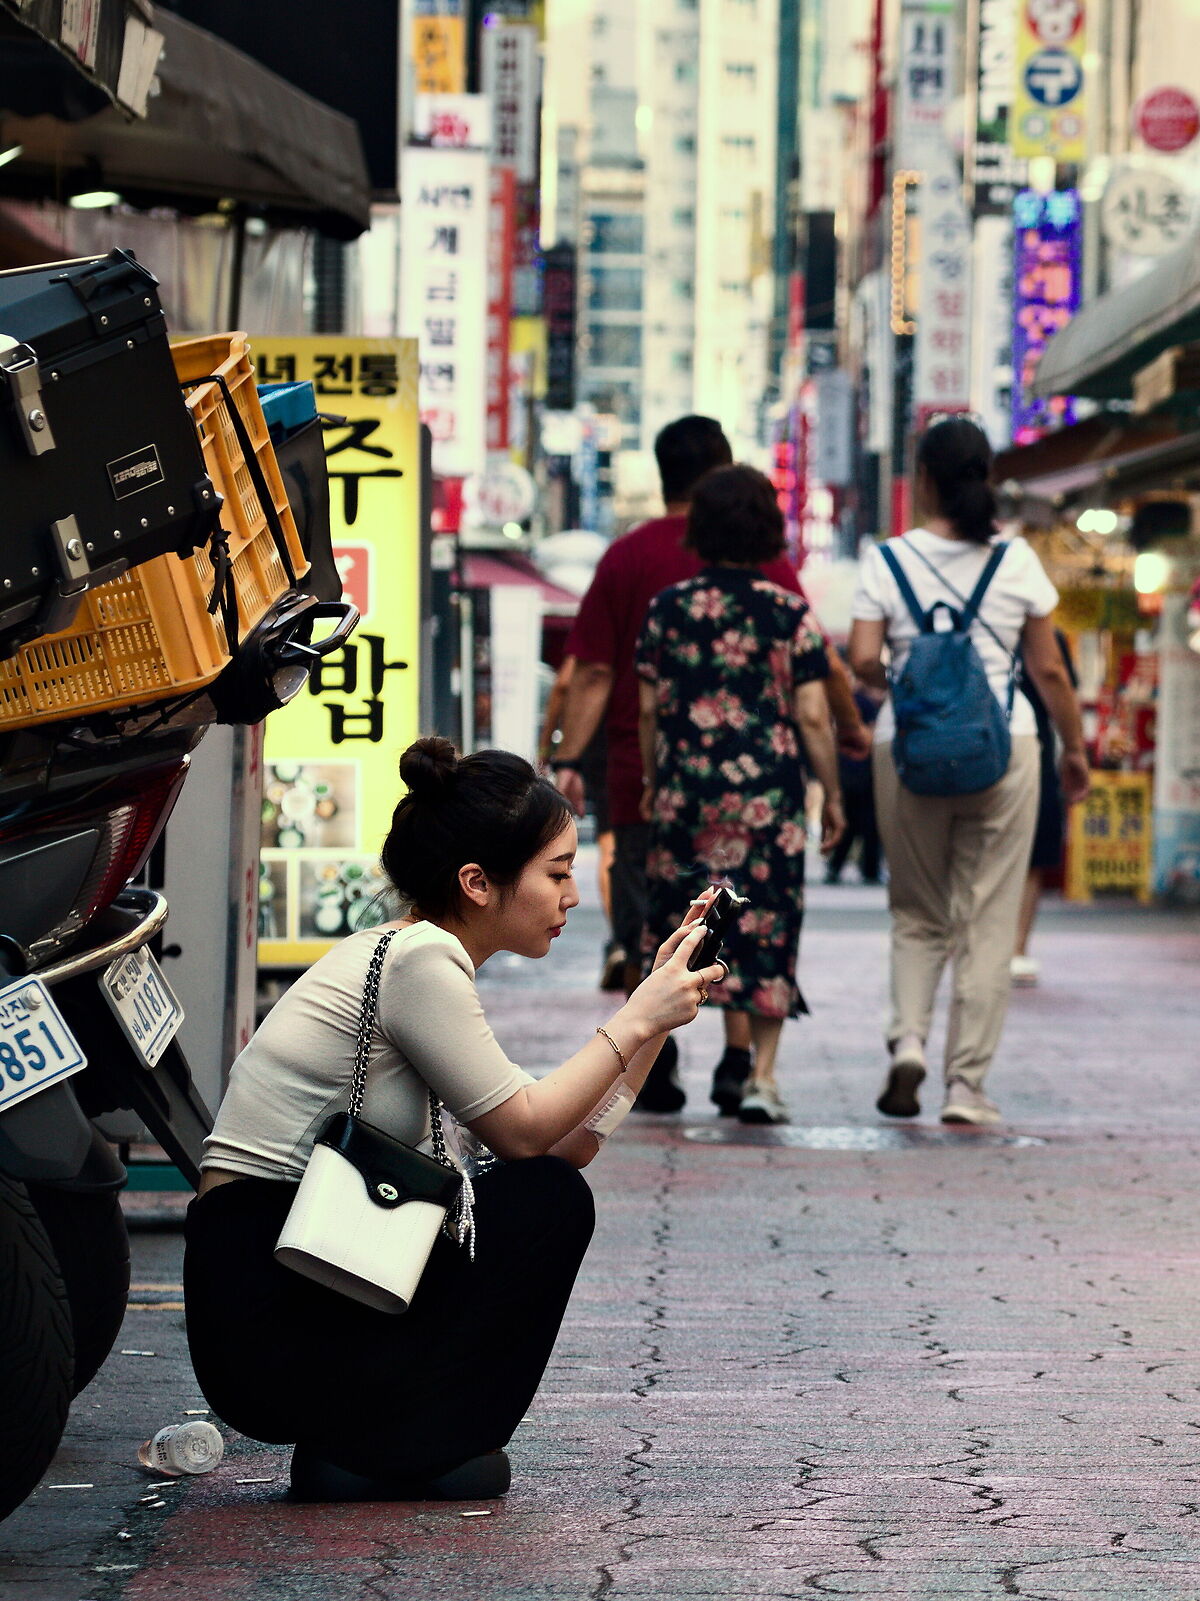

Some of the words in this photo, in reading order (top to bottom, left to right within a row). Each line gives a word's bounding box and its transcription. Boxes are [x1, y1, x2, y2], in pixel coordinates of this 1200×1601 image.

[313, 353, 399, 397] 전통
[308, 633, 409, 744] 밥
[132, 972, 168, 1033] 4187
[0, 1020, 65, 1092] 851
